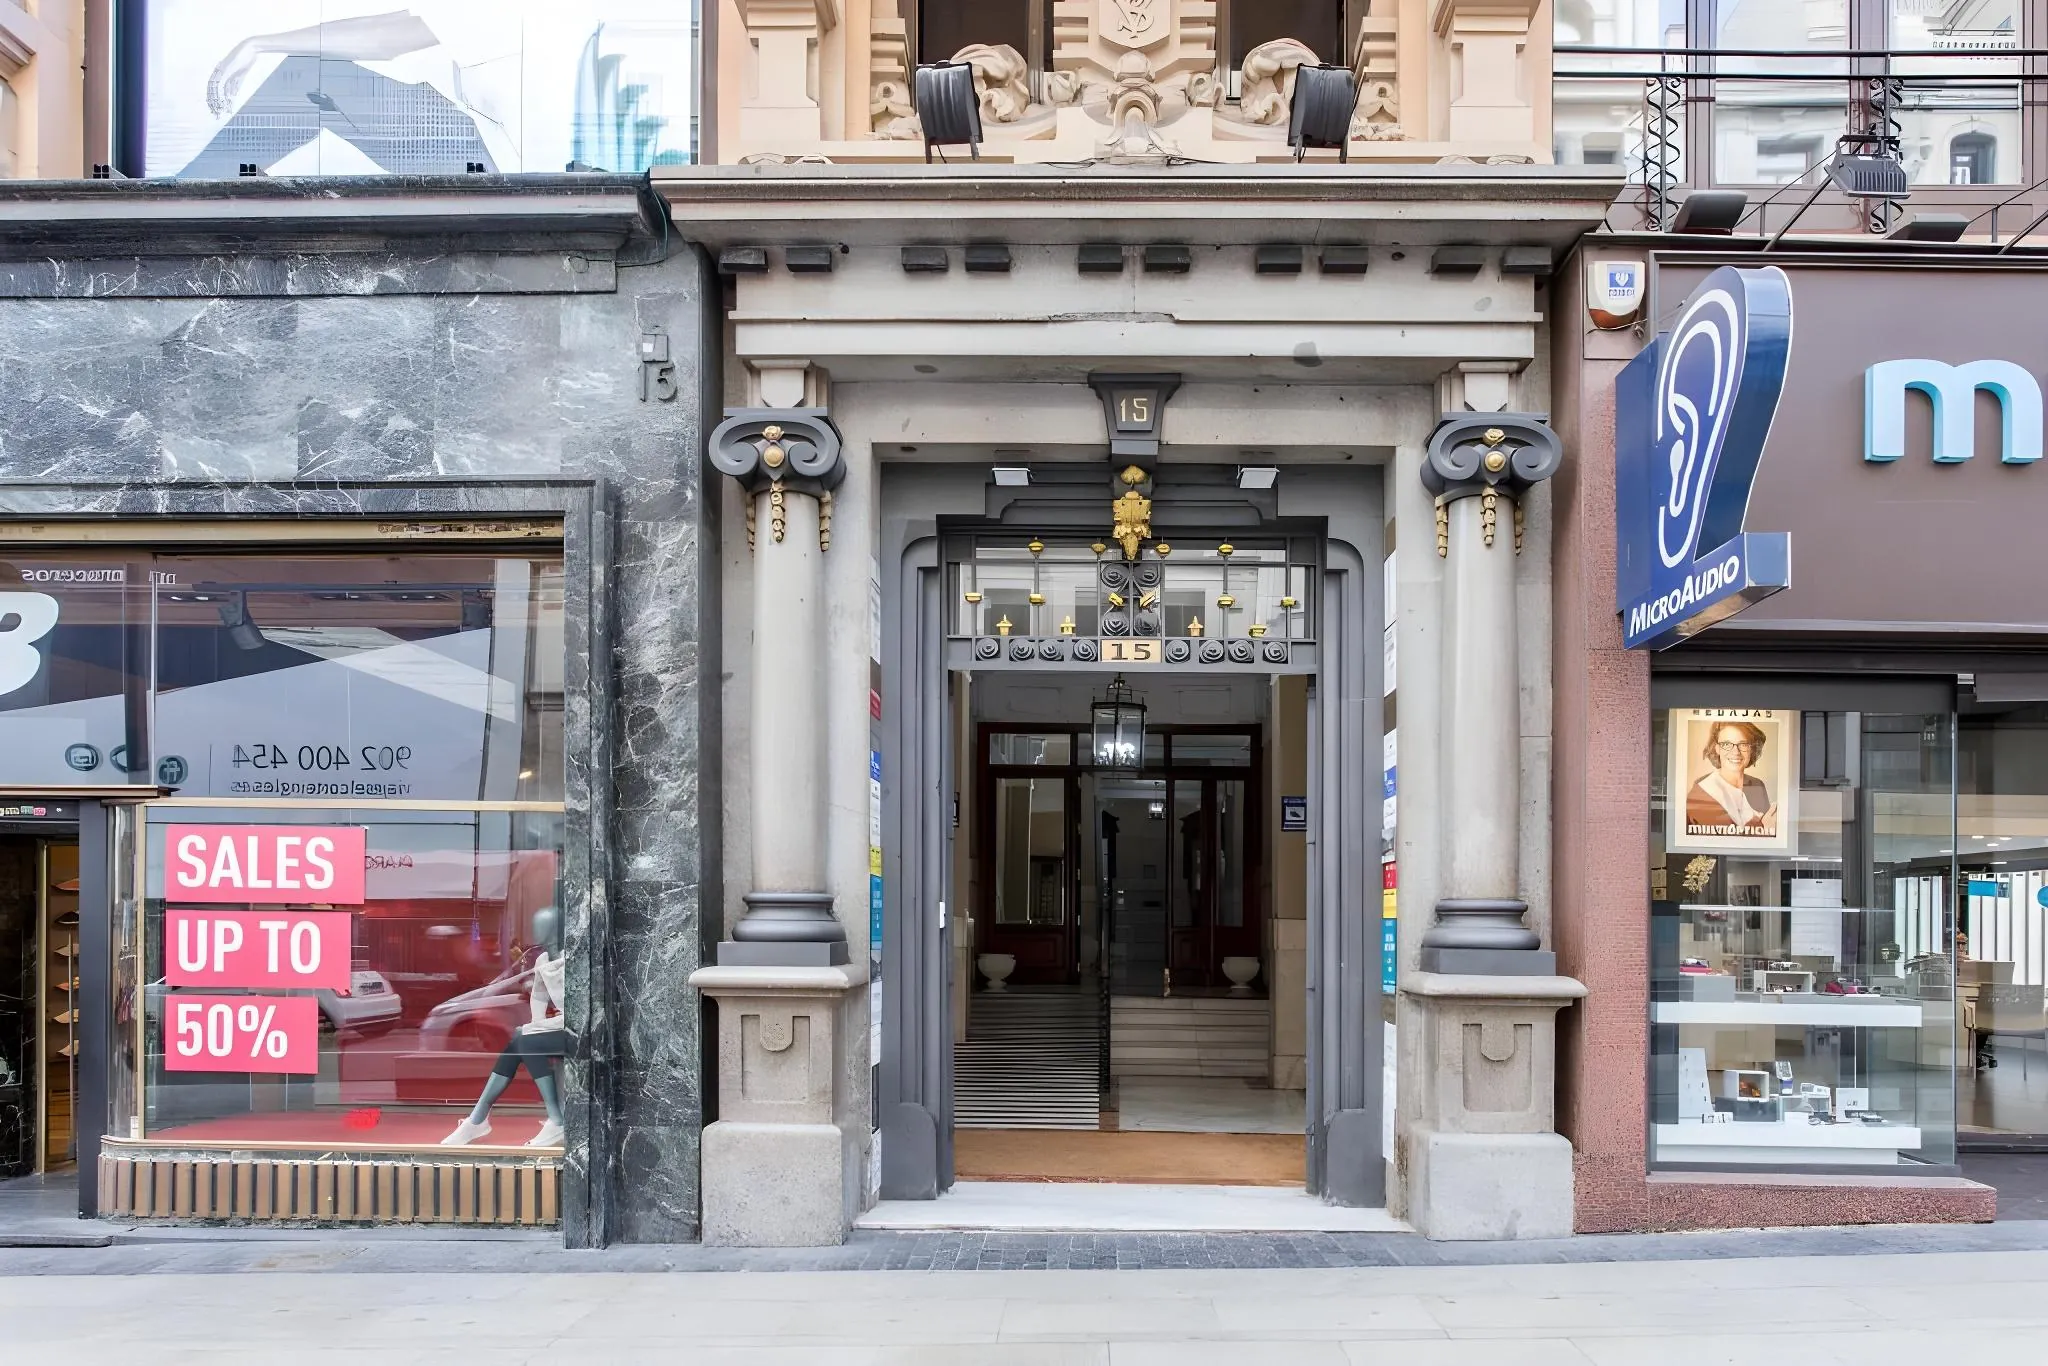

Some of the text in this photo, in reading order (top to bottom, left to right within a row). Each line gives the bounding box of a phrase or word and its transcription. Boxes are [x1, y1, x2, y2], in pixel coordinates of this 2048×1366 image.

[638, 363, 678, 402] 15
[1120, 398, 1148, 422] 15
[1864, 359, 2044, 464] m
[1111, 643, 1151, 660] 15
[177, 834, 335, 890] SALES
[177, 919, 321, 974] UP TO
[176, 1003, 289, 1058] 50%
